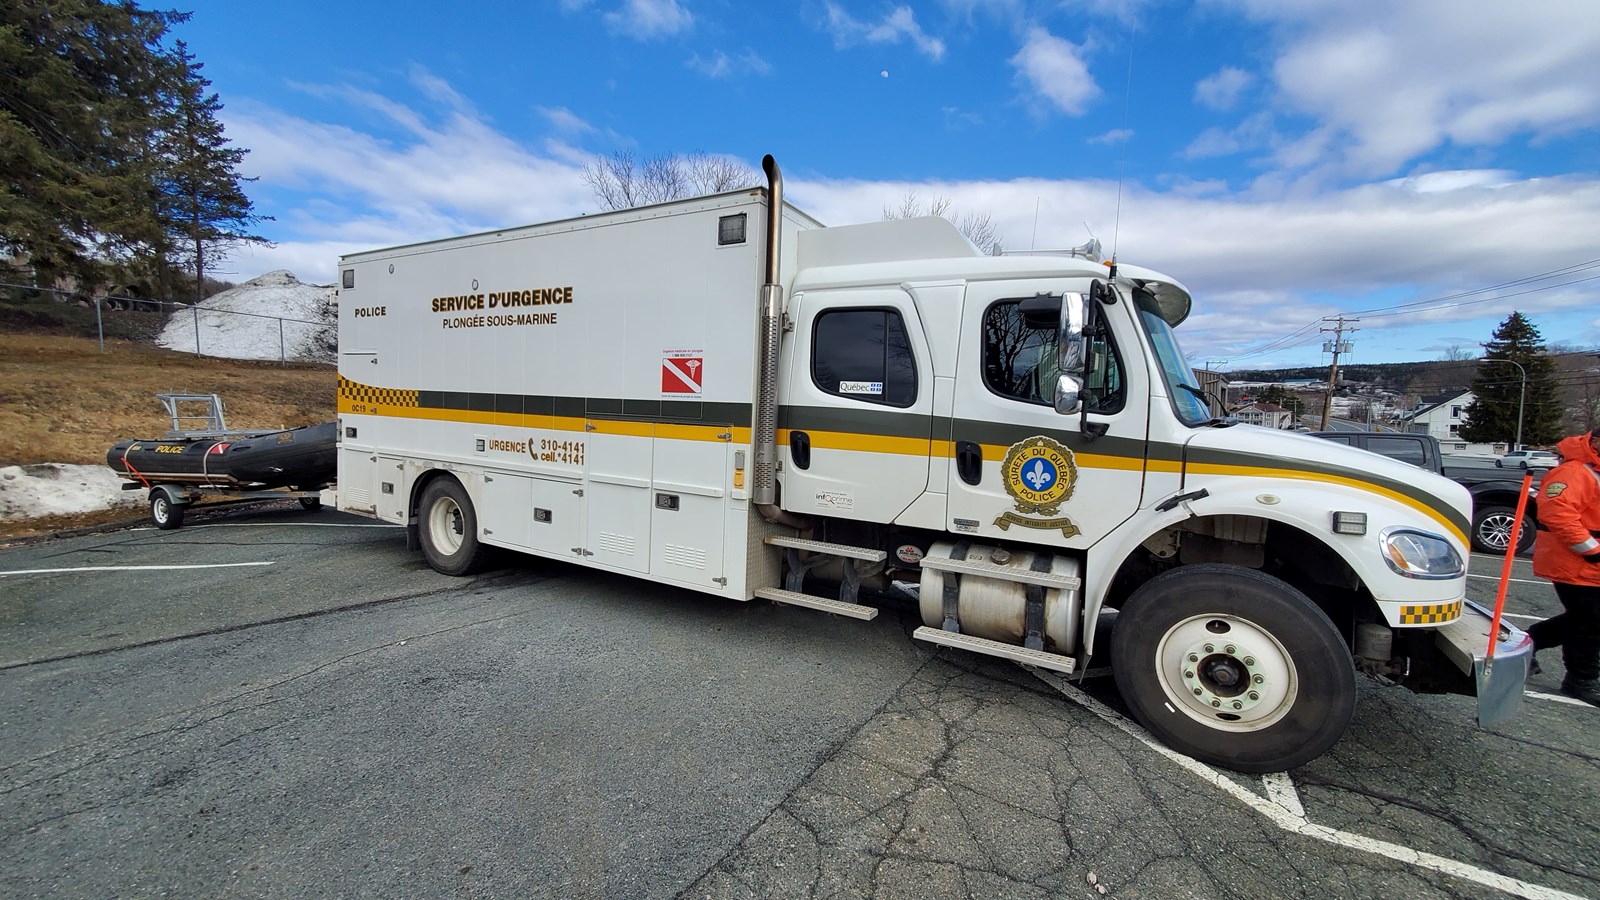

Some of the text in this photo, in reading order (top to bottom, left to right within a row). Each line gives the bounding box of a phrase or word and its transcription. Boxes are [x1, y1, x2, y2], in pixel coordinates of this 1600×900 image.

[431, 286, 573, 312] SERVICE D'URGENCE
[354, 306, 387, 318] POLICE
[442, 313, 557, 329] PLONGÉE SOUS-MARINE
[840, 382, 870, 392] Québec
[154, 445, 186, 454] POLICE
[489, 440, 526, 453] URGENCE
[540, 439, 585, 454] 310-4141
[1032, 448, 1046, 457] DU
[1020, 488, 1056, 502] POLICE
